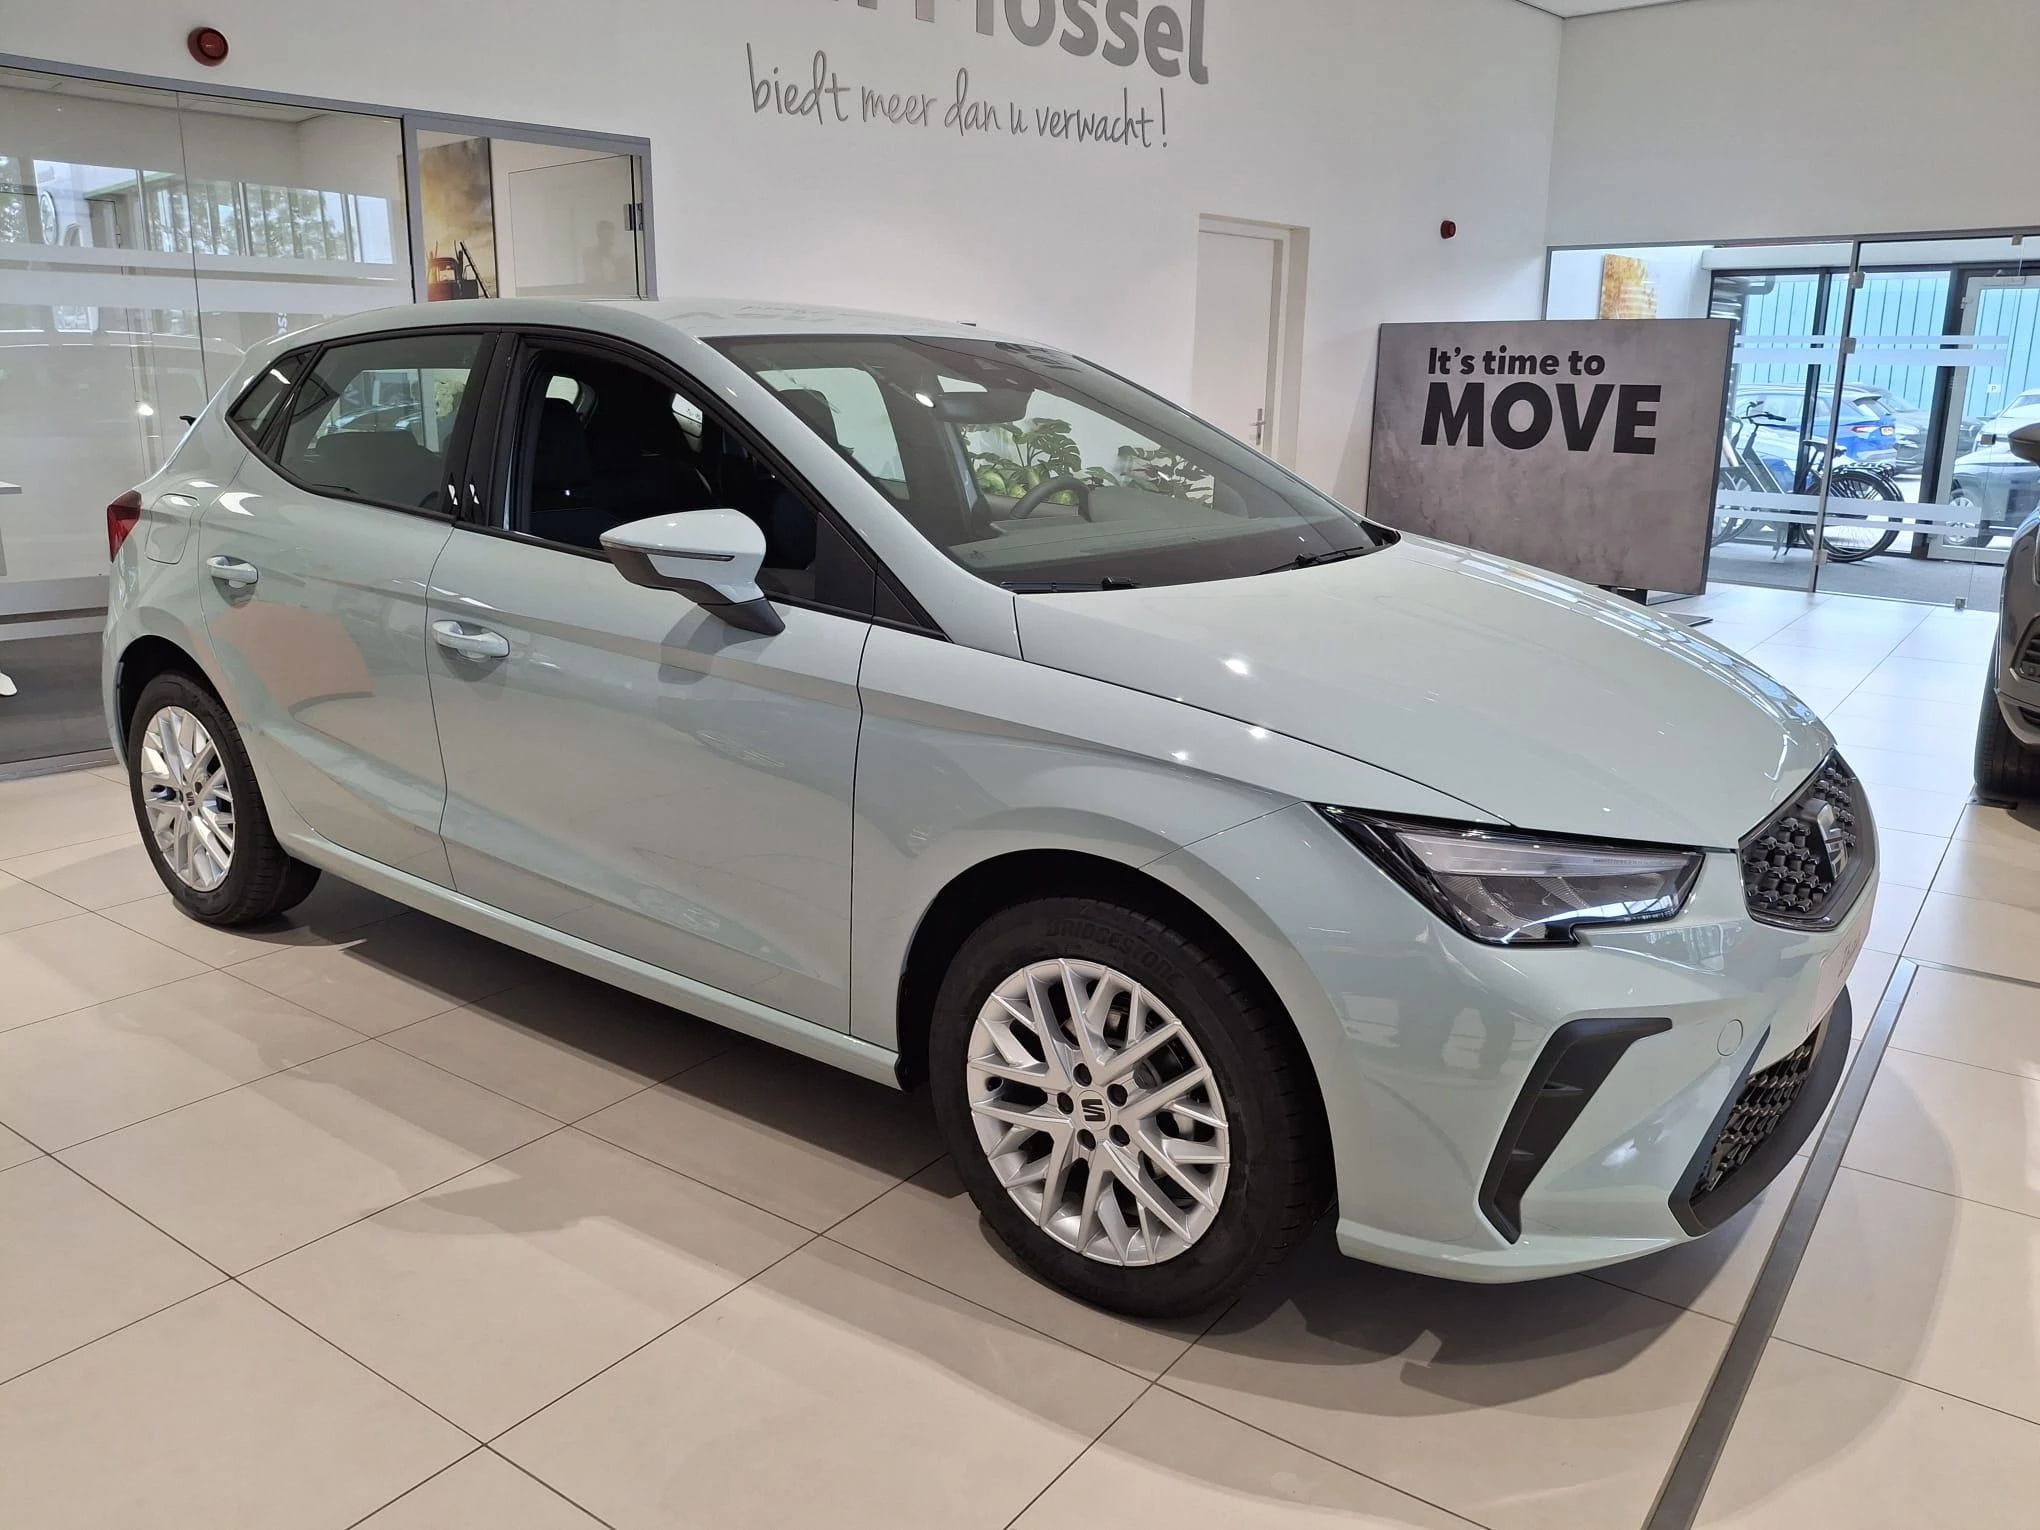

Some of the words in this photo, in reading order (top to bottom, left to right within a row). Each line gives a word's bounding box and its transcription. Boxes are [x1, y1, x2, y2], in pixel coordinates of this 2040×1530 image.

[747, 42, 850, 125] biedt
[862, 84, 937, 127] meer
[944, 68, 1001, 136] dan
[1010, 102, 1028, 134] u
[1036, 87, 1169, 148] verwacht!
[1428, 347, 1475, 375] It's
[1482, 345, 1560, 375] time
[1568, 350, 1606, 375] to
[1421, 381, 1662, 455] MOVE
